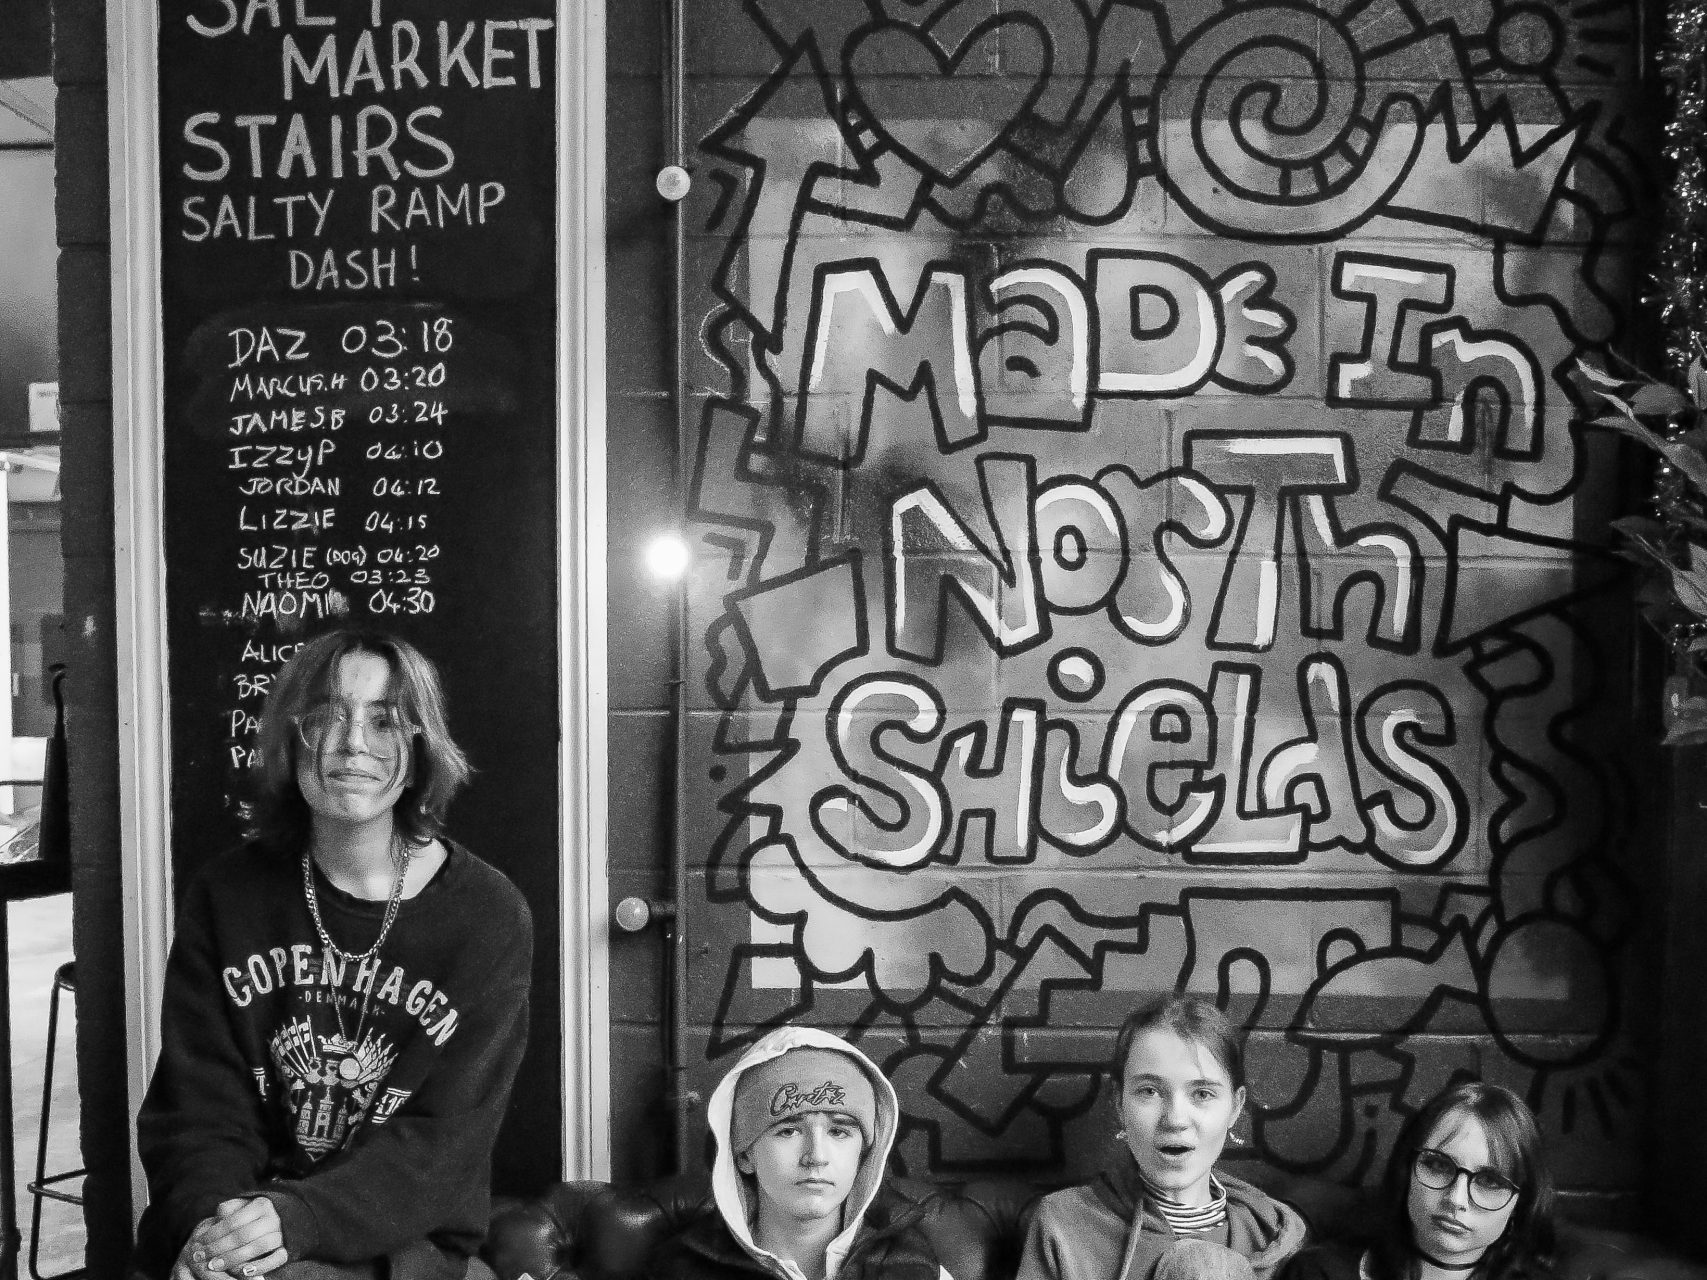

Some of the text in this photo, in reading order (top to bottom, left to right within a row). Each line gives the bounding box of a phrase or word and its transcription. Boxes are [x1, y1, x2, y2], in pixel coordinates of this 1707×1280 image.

[281, 18, 555, 101] MARKET
[183, 105, 455, 182] STAIRS
[182, 182, 506, 242] SALTY RAMP
[228, 317, 453, 369] DAZ 03:18
[360, 362, 446, 392] 03:20
[368, 401, 449, 426] 03:24
[366, 441, 444, 460] 04:10
[238, 477, 441, 497] JORDAN 04:12
[239, 505, 428, 534] LIZZIE 04:15
[237, 545, 318, 569] SUZIE
[377, 545, 440, 564] 04:20
[257, 568, 431, 590] THEO 03:23
[241, 586, 436, 619] NAOMI 04:30
[223, 944, 459, 1048] COPENHAGEN
